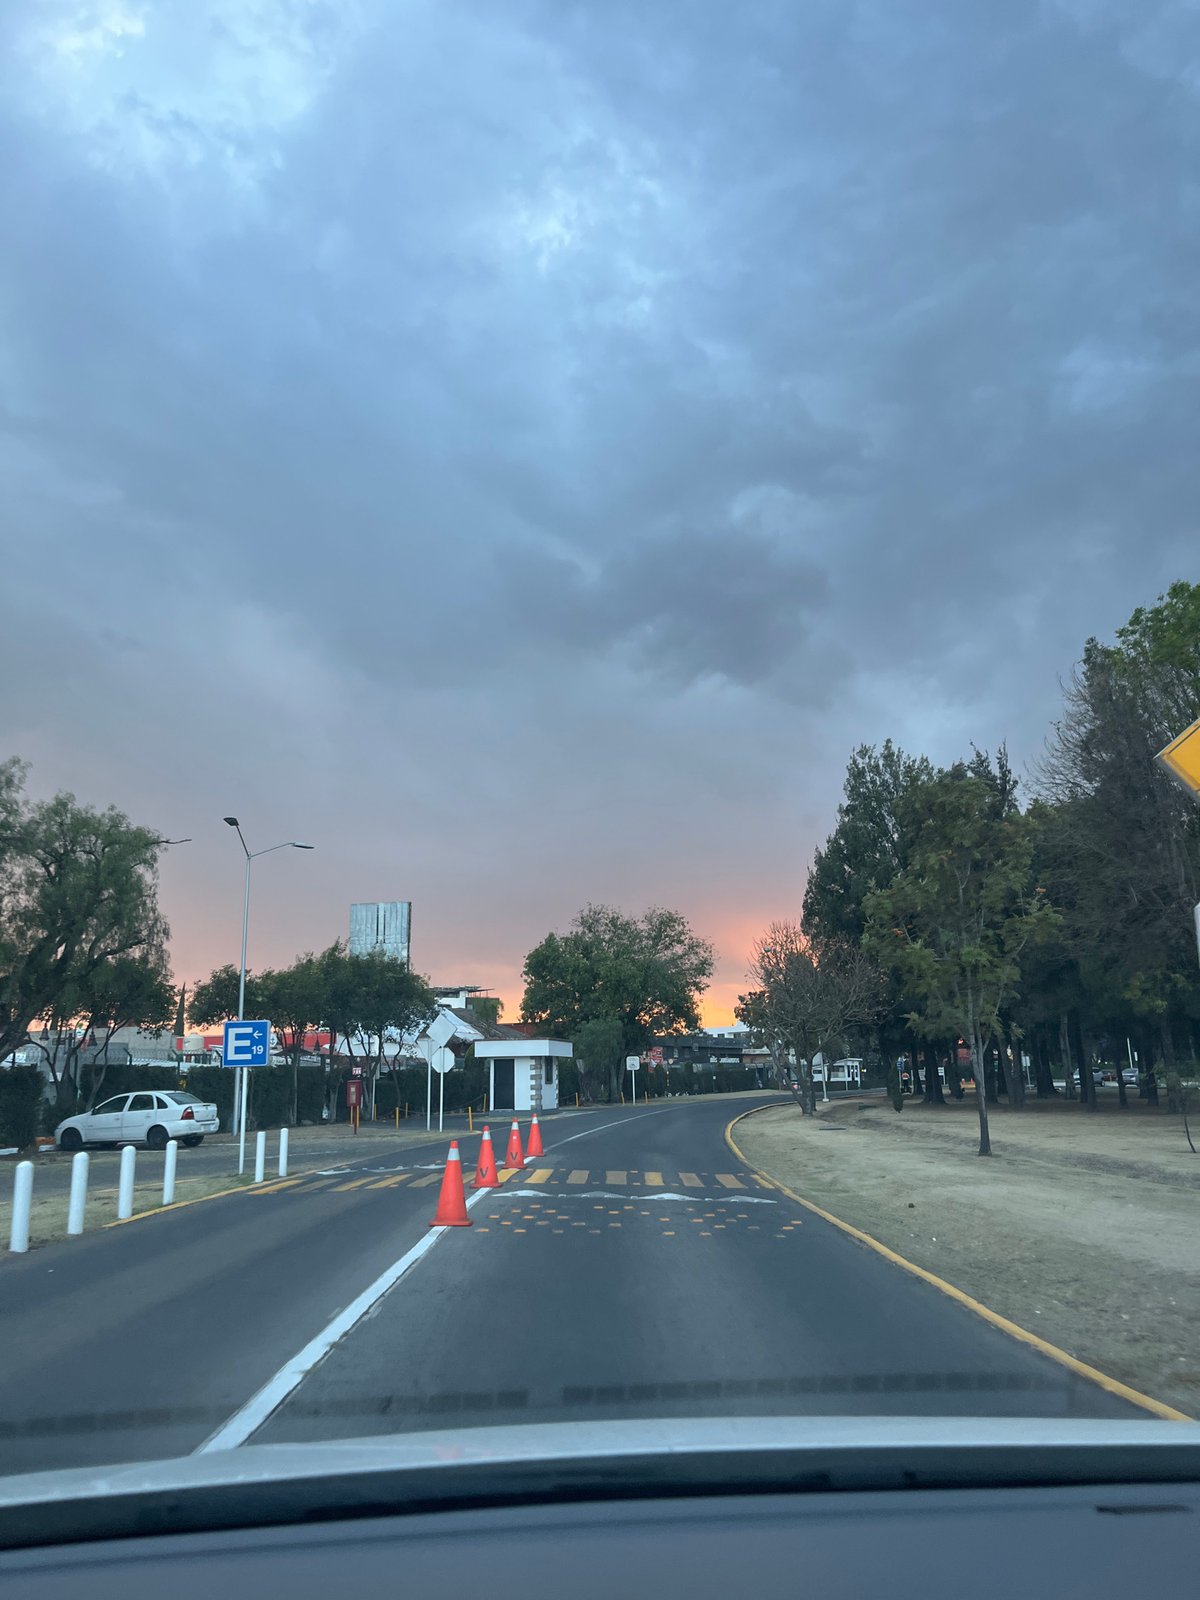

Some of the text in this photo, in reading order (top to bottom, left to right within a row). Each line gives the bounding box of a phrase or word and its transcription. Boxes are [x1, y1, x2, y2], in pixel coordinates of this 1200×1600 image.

[227, 1027, 253, 1060] E
[251, 1045, 264, 1055] 19
[480, 1166, 489, 1179] V
